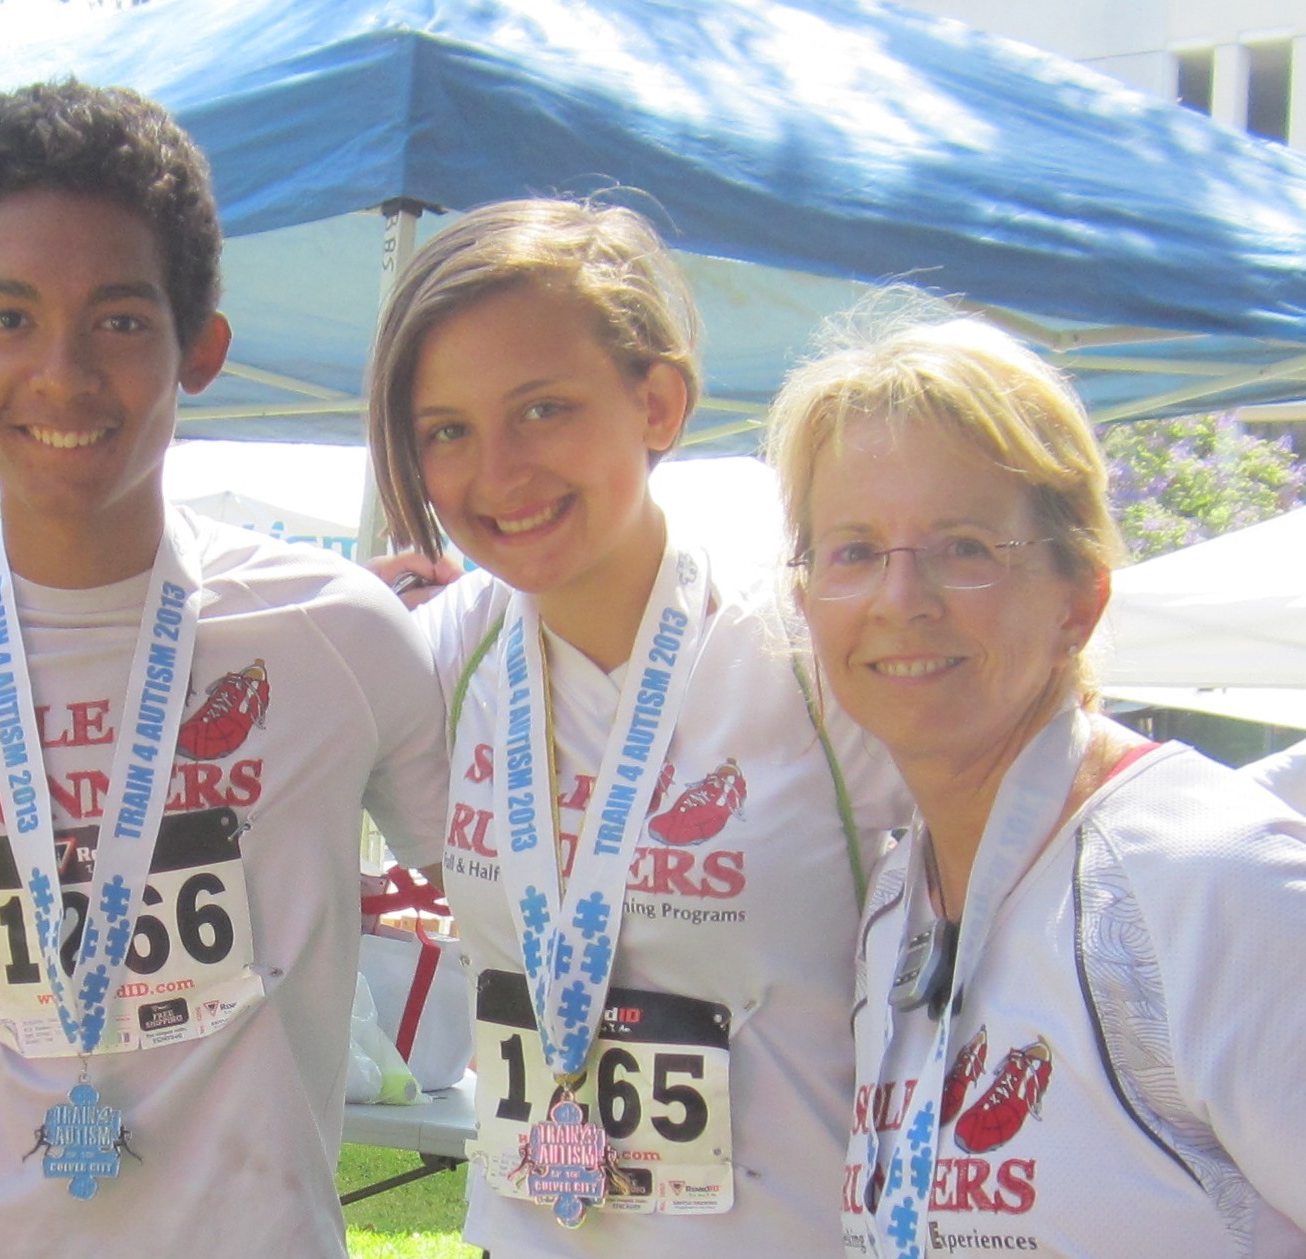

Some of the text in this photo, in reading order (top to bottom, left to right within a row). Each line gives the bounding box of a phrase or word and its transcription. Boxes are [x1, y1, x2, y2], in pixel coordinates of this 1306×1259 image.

[114, 580, 186, 839] TRAIN 4 AUTISM 2013
[506, 615, 539, 854] TRAIN 4 AUTISM 2013
[593, 606, 689, 856] TRAIN 4 AUTISM 2013
[8, 769, 39, 835] 2013
[468, 860, 501, 882] Half
[622, 898, 746, 925] ning Programs
[55, 1105, 95, 1125] TRAIN
[55, 1124, 112, 1146] AUTISM
[539, 1124, 580, 1143] TRAIN
[539, 1144, 597, 1166] AUTISM
